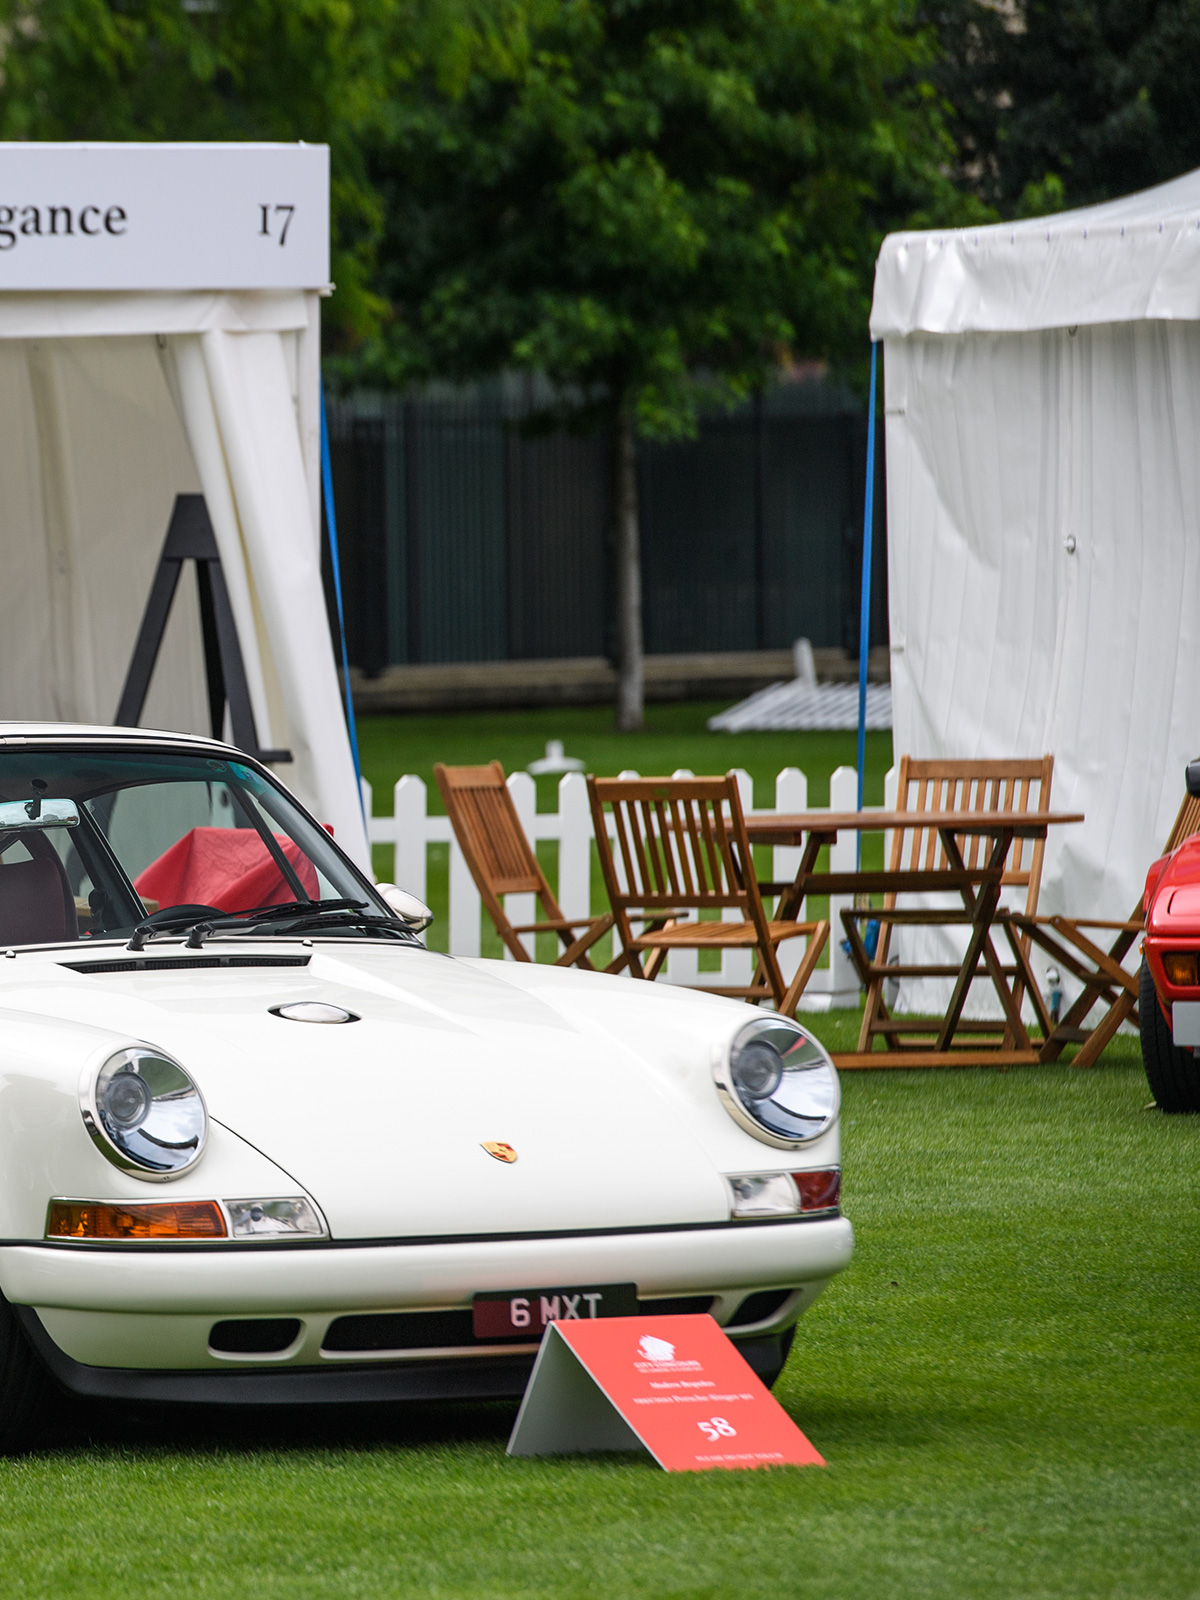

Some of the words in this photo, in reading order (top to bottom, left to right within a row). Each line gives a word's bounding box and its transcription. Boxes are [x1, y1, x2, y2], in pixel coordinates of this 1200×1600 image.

[258, 203, 296, 247] 17
[510, 1297, 531, 1327] 6
[540, 1293, 603, 1326] MXT
[696, 1416, 737, 1442] 58
